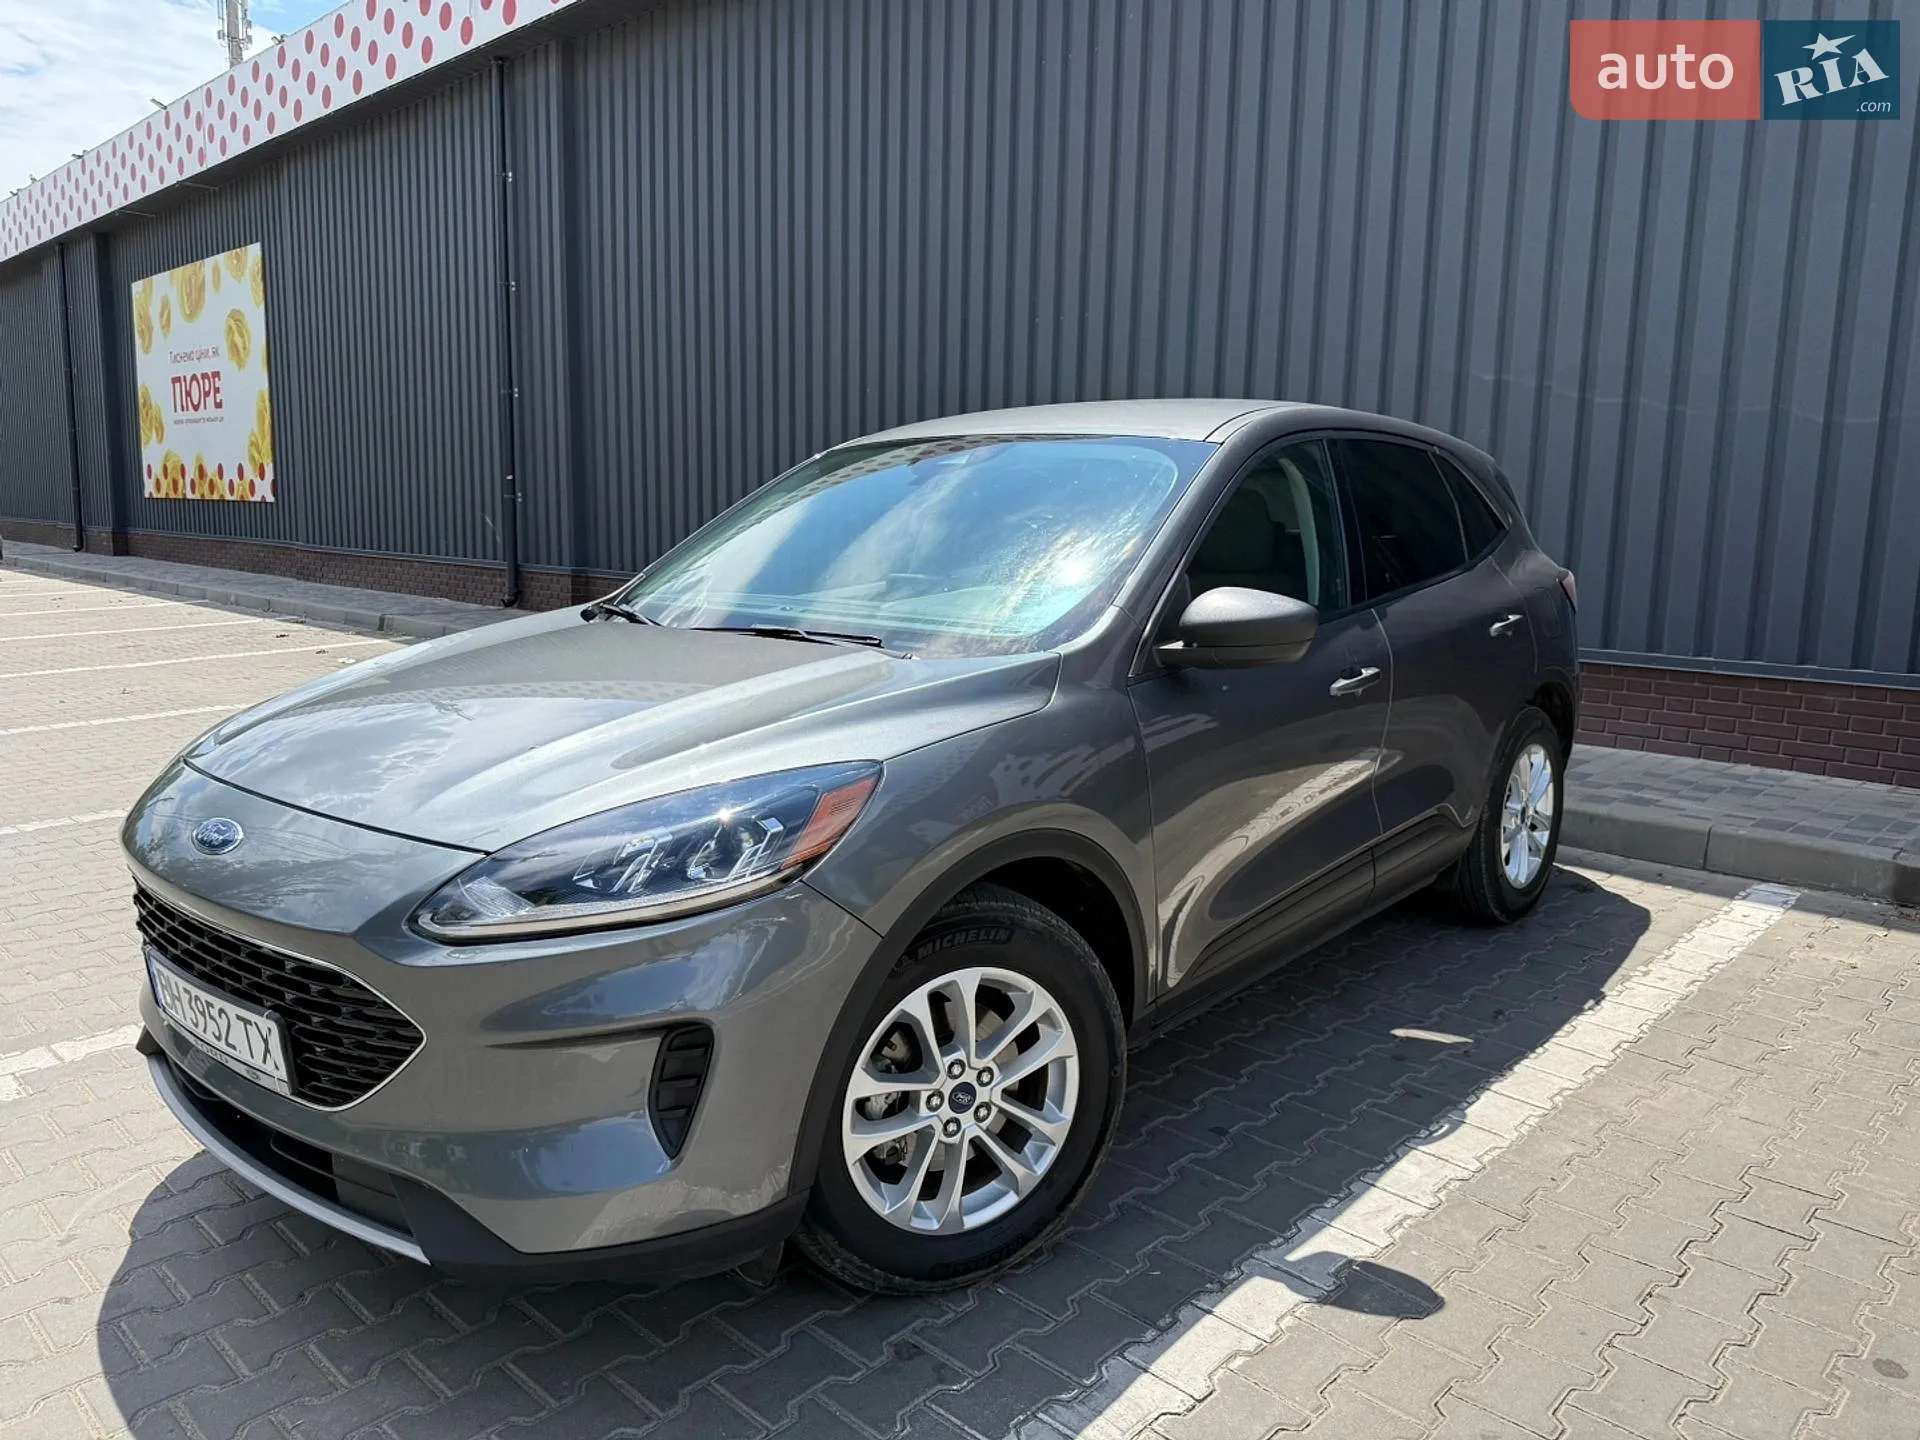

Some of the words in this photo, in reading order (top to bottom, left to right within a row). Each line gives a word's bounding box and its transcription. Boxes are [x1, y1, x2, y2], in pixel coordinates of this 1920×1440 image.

[171, 371, 222, 413] ПЮРЕ
[917, 927, 1011, 960] MICHELIN
[182, 986, 237, 1052] 3952
[235, 1013, 280, 1071] TX
